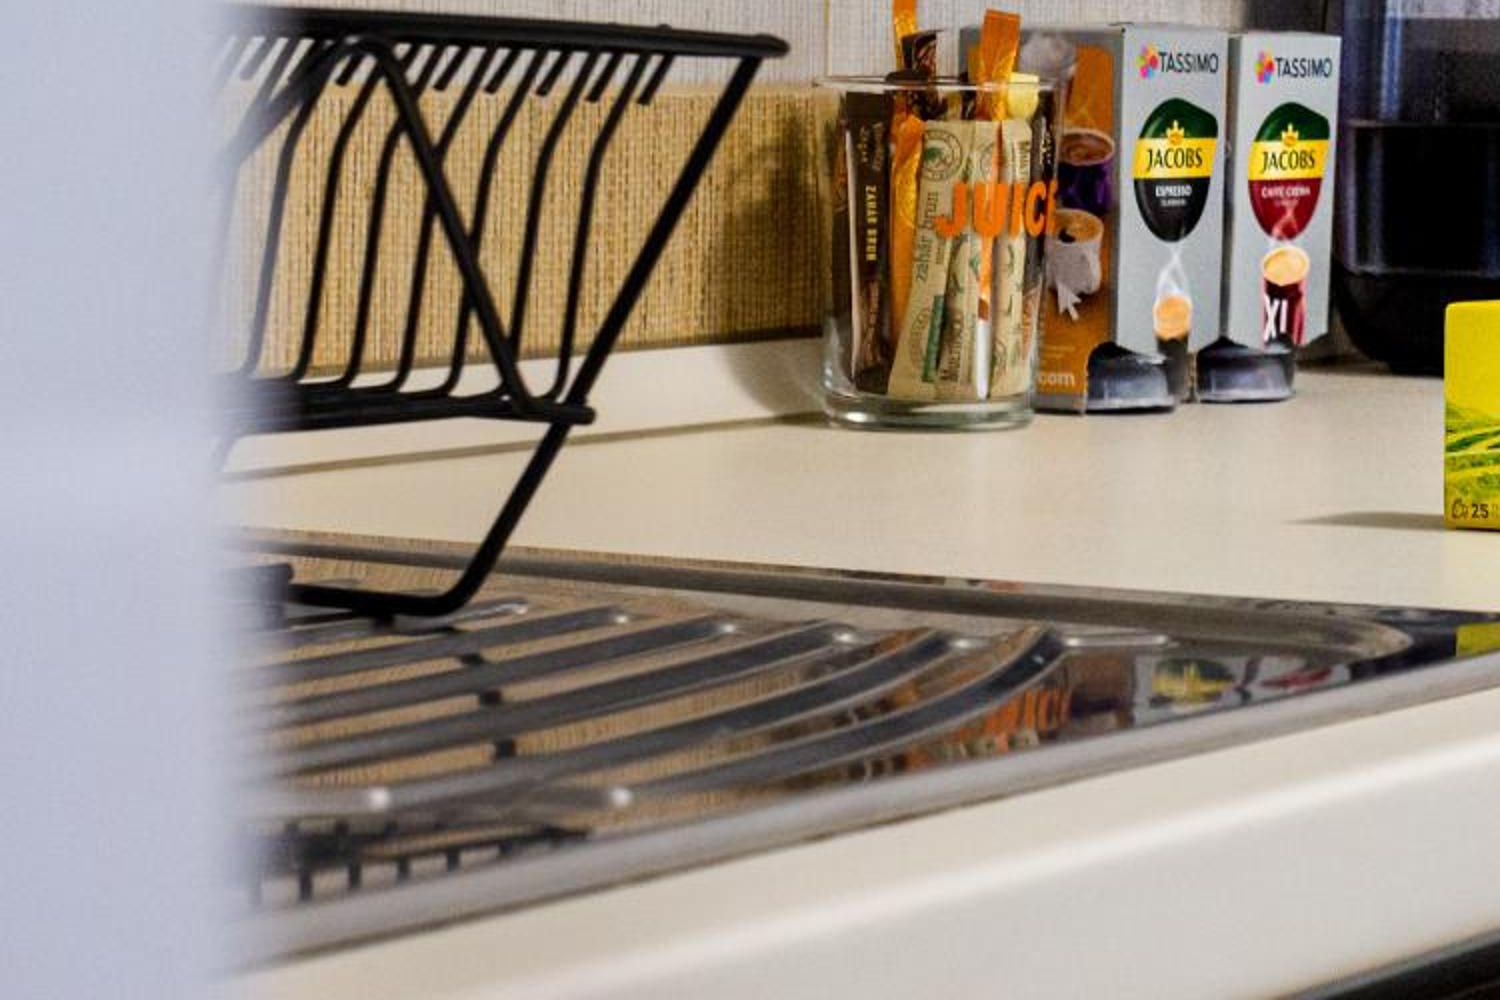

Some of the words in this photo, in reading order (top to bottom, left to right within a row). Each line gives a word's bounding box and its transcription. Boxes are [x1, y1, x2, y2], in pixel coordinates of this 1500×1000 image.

[1158, 53, 1219, 75] TASSIMO
[1275, 57, 1333, 79] TASSIMO
[1147, 148, 1203, 172] JACOBS
[1261, 150, 1316, 174] JACOBS
[1471, 503, 1489, 519] 25
